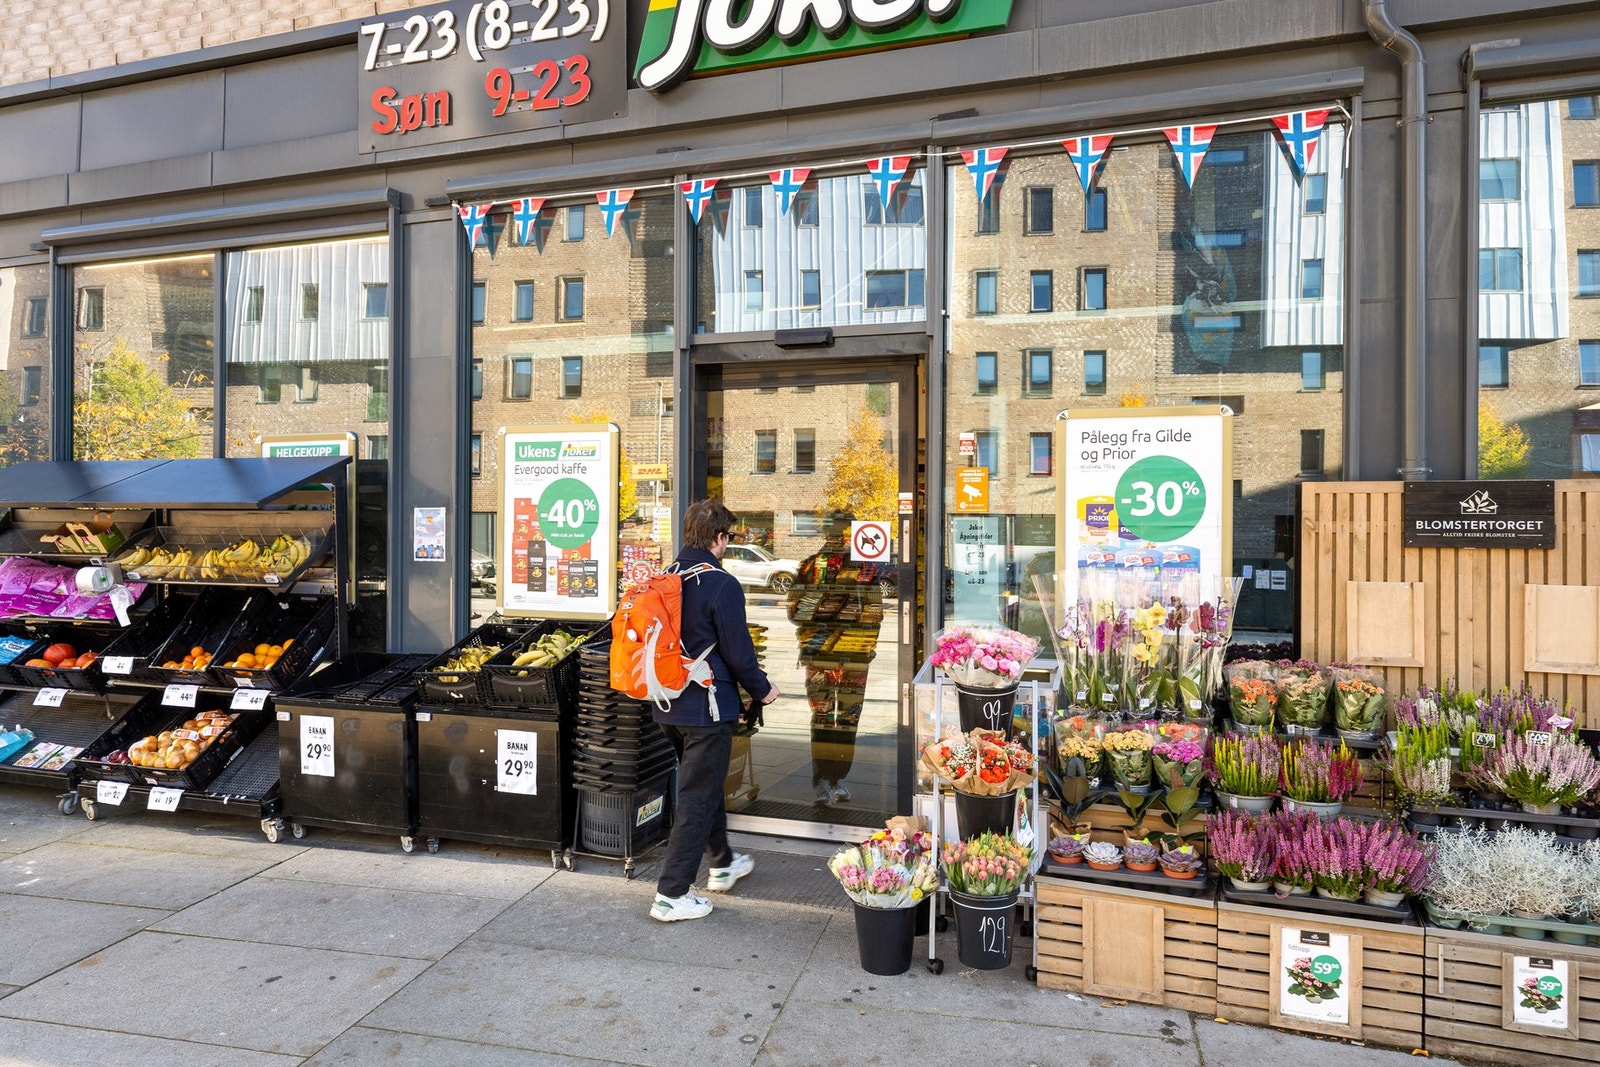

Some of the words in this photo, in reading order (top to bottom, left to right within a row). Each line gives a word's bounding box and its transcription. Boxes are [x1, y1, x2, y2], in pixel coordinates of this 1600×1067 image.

[361, 9, 458, 71] 7-23
[371, 85, 450, 135] Søn
[484, 54, 592, 117] 9-23
[1081, 429, 1128, 446] Pålegg
[1132, 429, 1151, 443] fra
[1155, 428, 1192, 442] Gilde
[276, 446, 332, 458] HELGEKUPP
[518, 444, 557, 458] Ukens
[1081, 450, 1098, 463] og
[1102, 447, 1136, 460] Prior
[514, 463, 559, 477] Evergood
[561, 462, 587, 475] kaffe
[637, 467, 662, 475] DHL
[1121, 480, 1200, 517] -30%
[540, 498, 597, 528] -40%
[1416, 520, 1544, 531] BLOMSTERTORGET
[507, 742, 528, 751] BANAN
